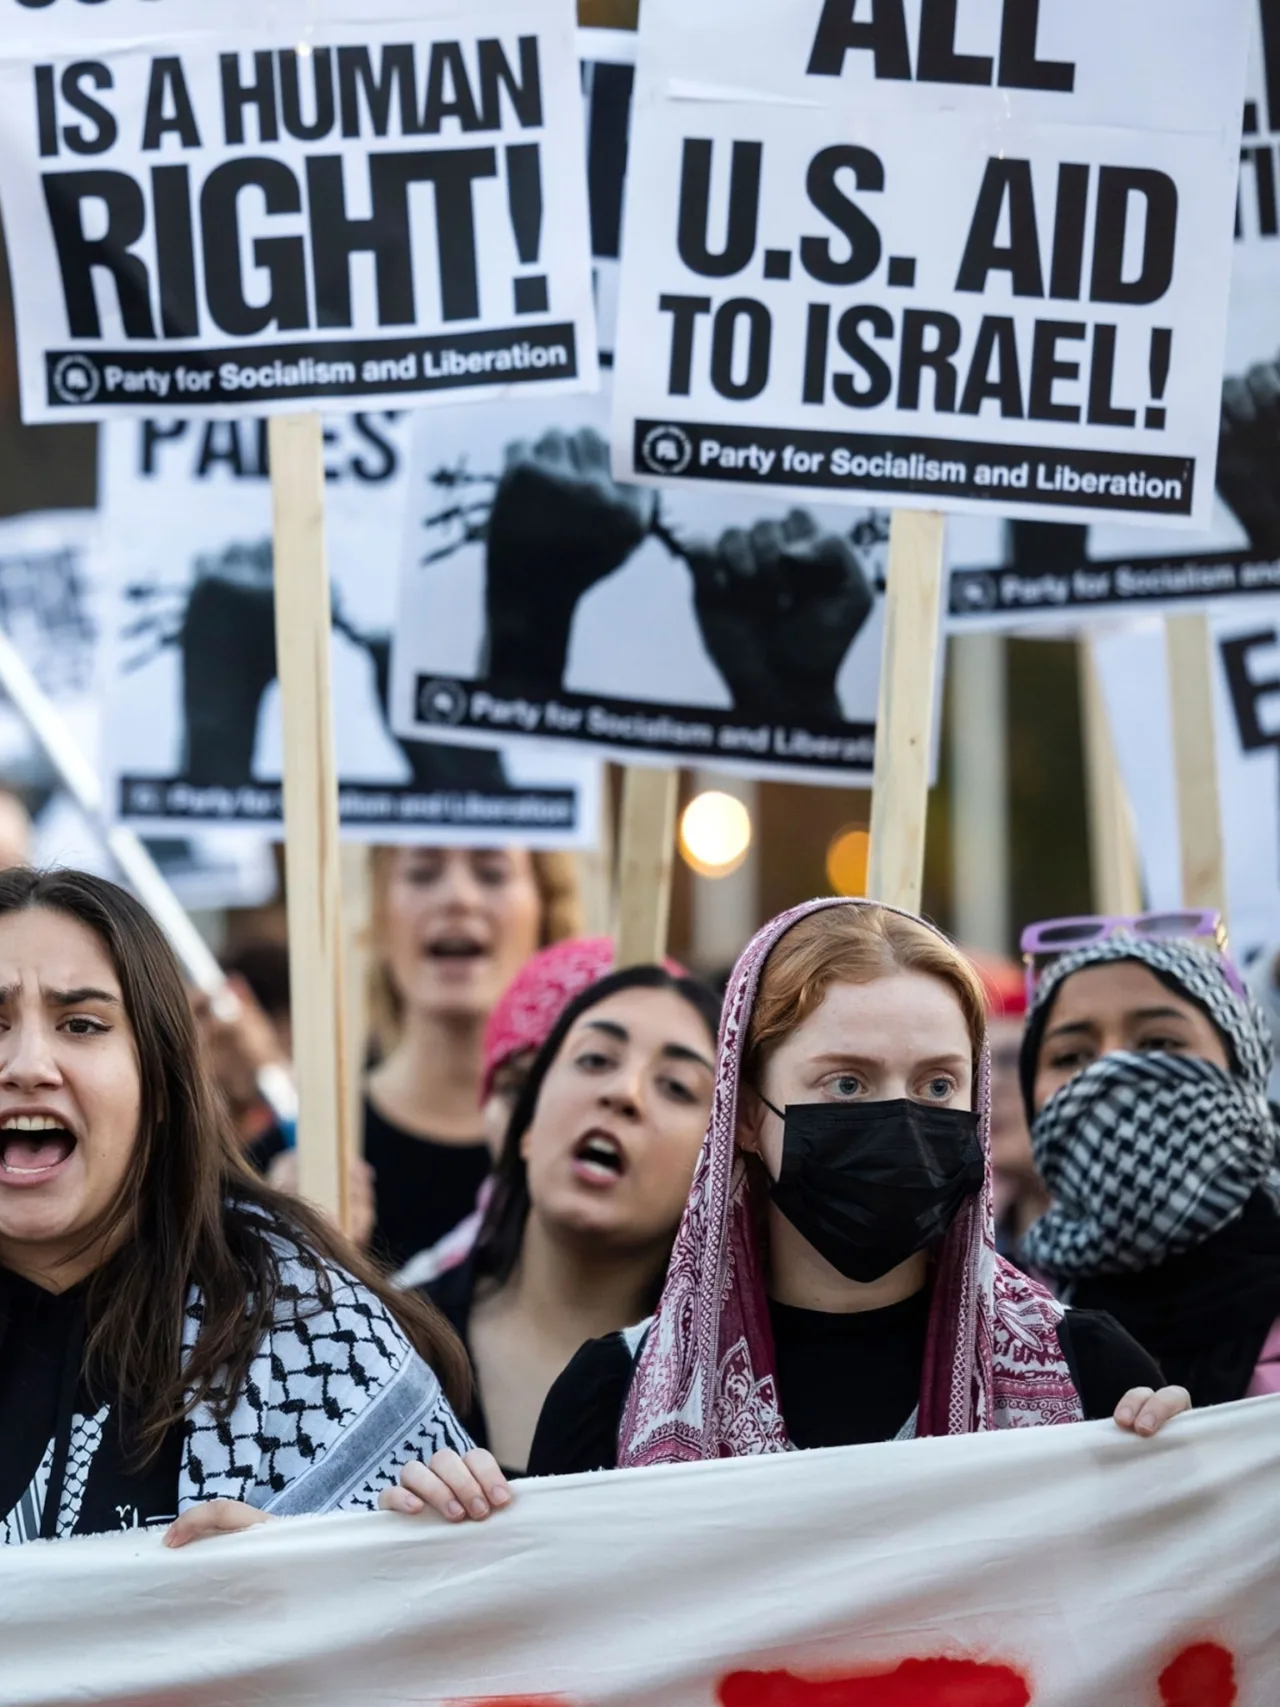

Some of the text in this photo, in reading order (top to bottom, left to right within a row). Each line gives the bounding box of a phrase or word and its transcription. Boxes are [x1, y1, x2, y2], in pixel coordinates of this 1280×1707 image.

[33, 35, 545, 157] IS A HUMAN
[41, 142, 550, 339] RIGHT!
[676, 138, 917, 287] U.S.
[953, 157, 1179, 306] AID
[104, 365, 170, 397] Party
[175, 366, 214, 392] for
[219, 358, 356, 391] Socialism
[362, 353, 417, 382] and
[423, 341, 568, 378] Liberation
[658, 293, 1173, 431] TO ISRAEL!
[699, 439, 775, 475] Party
[782, 445, 825, 473] for
[830, 448, 967, 483] Socialism
[973, 461, 1029, 488] and
[1036, 462, 1182, 500] Liberation
[472, 692, 541, 731] Party
